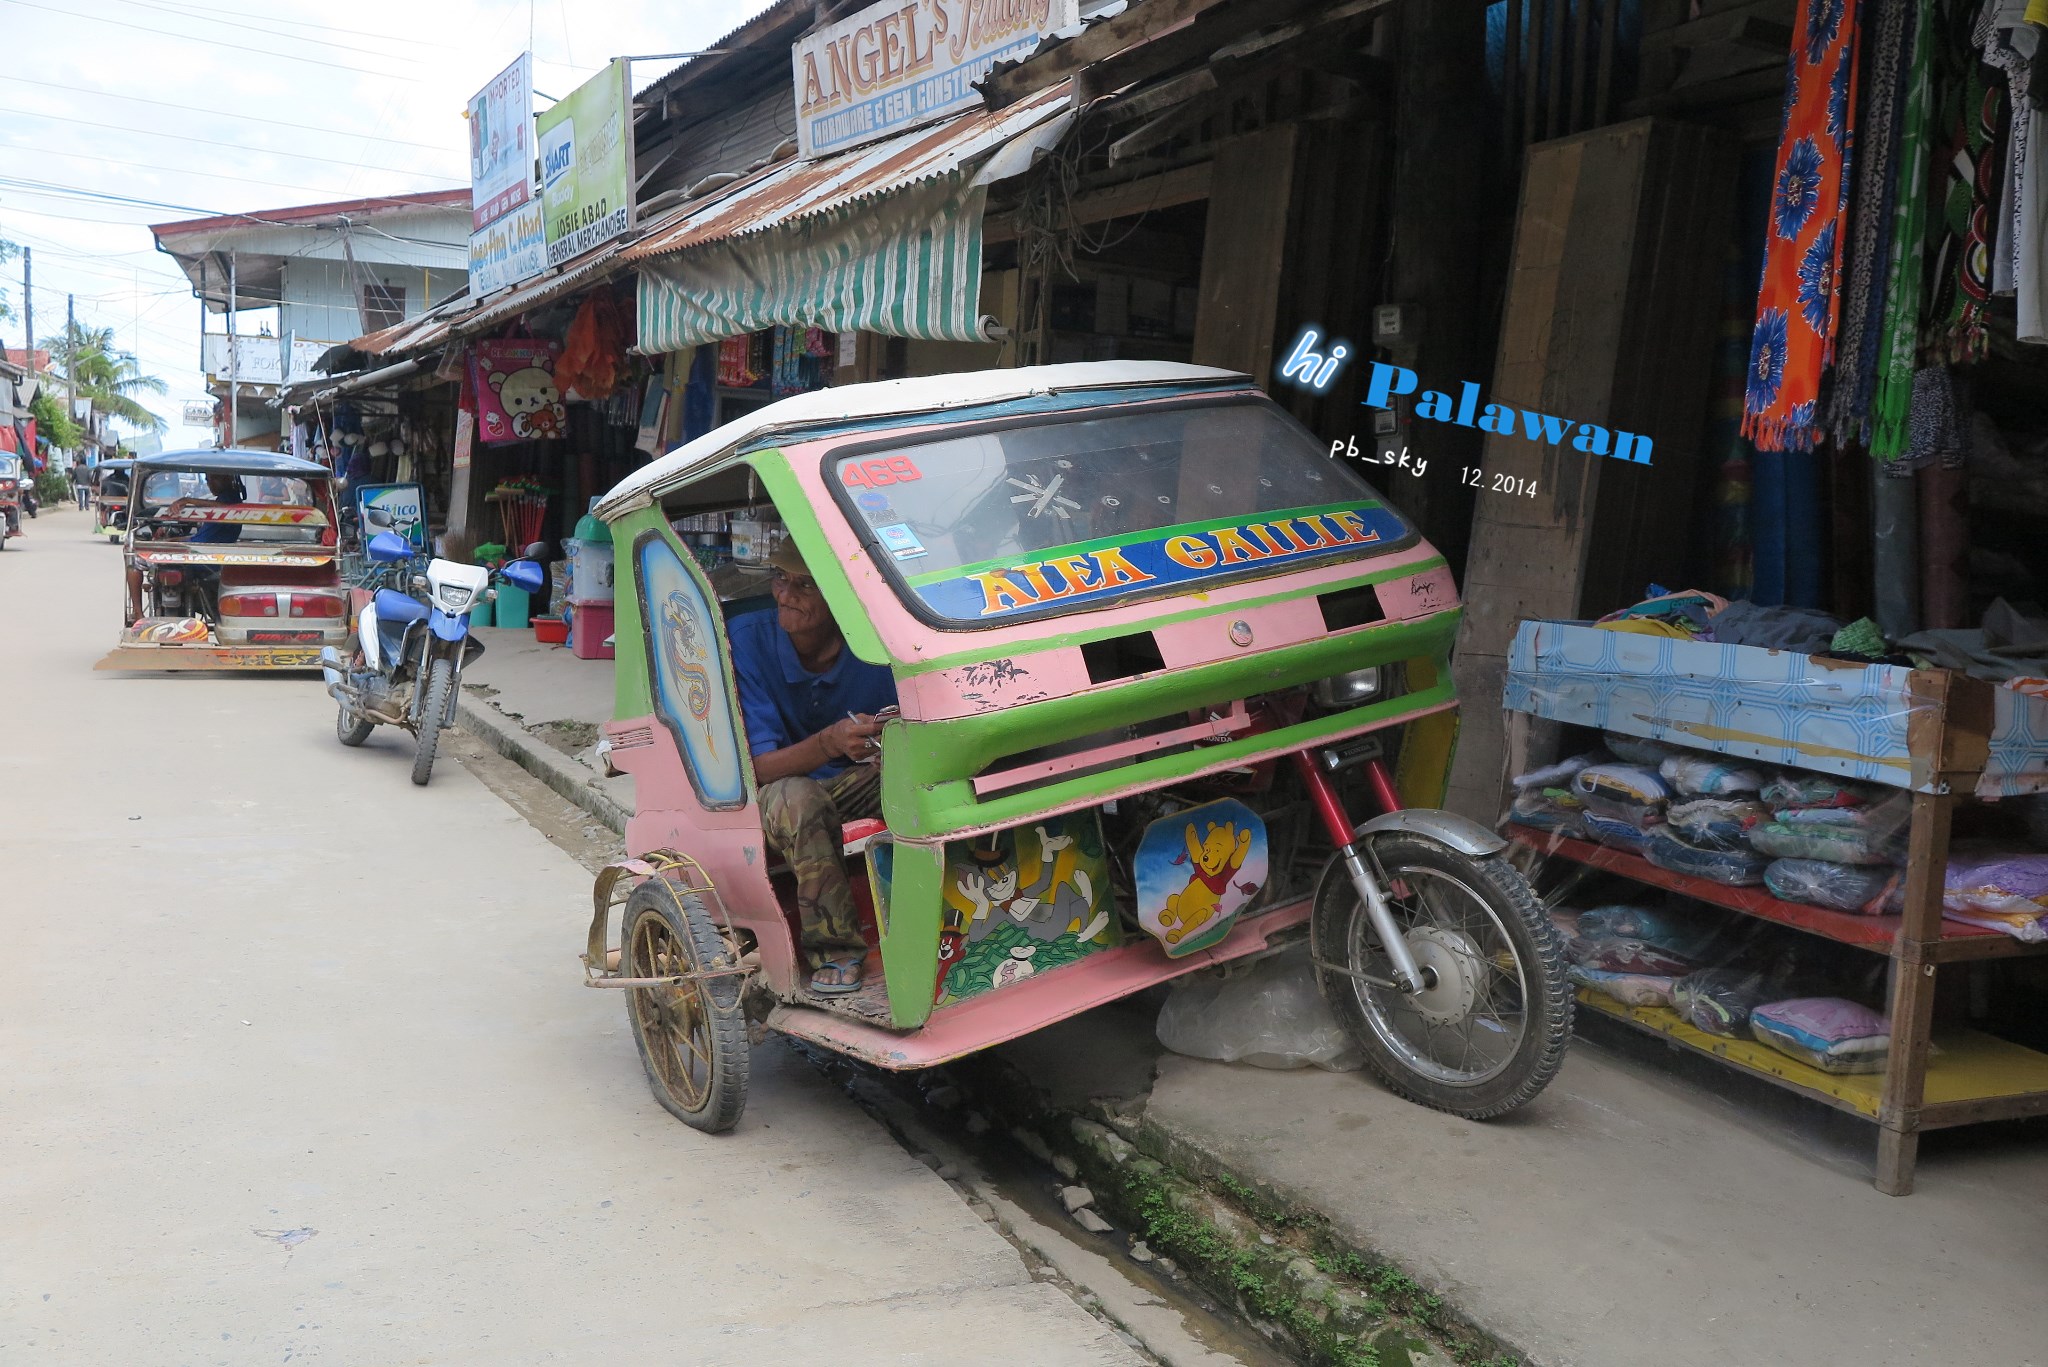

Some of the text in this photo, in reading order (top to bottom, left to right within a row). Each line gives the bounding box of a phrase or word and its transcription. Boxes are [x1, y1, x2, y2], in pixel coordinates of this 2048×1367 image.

[814, 103, 873, 146] HARDWARE
[545, 141, 571, 179] SMART
[548, 208, 627, 264] GENERAL MERCHANDISE
[556, 197, 607, 239] JOSIE ABAD
[842, 455, 923, 489] 469
[150, 553, 316, 565] METAL MULISHA
[964, 510, 1381, 616] ALEA GAILLE
